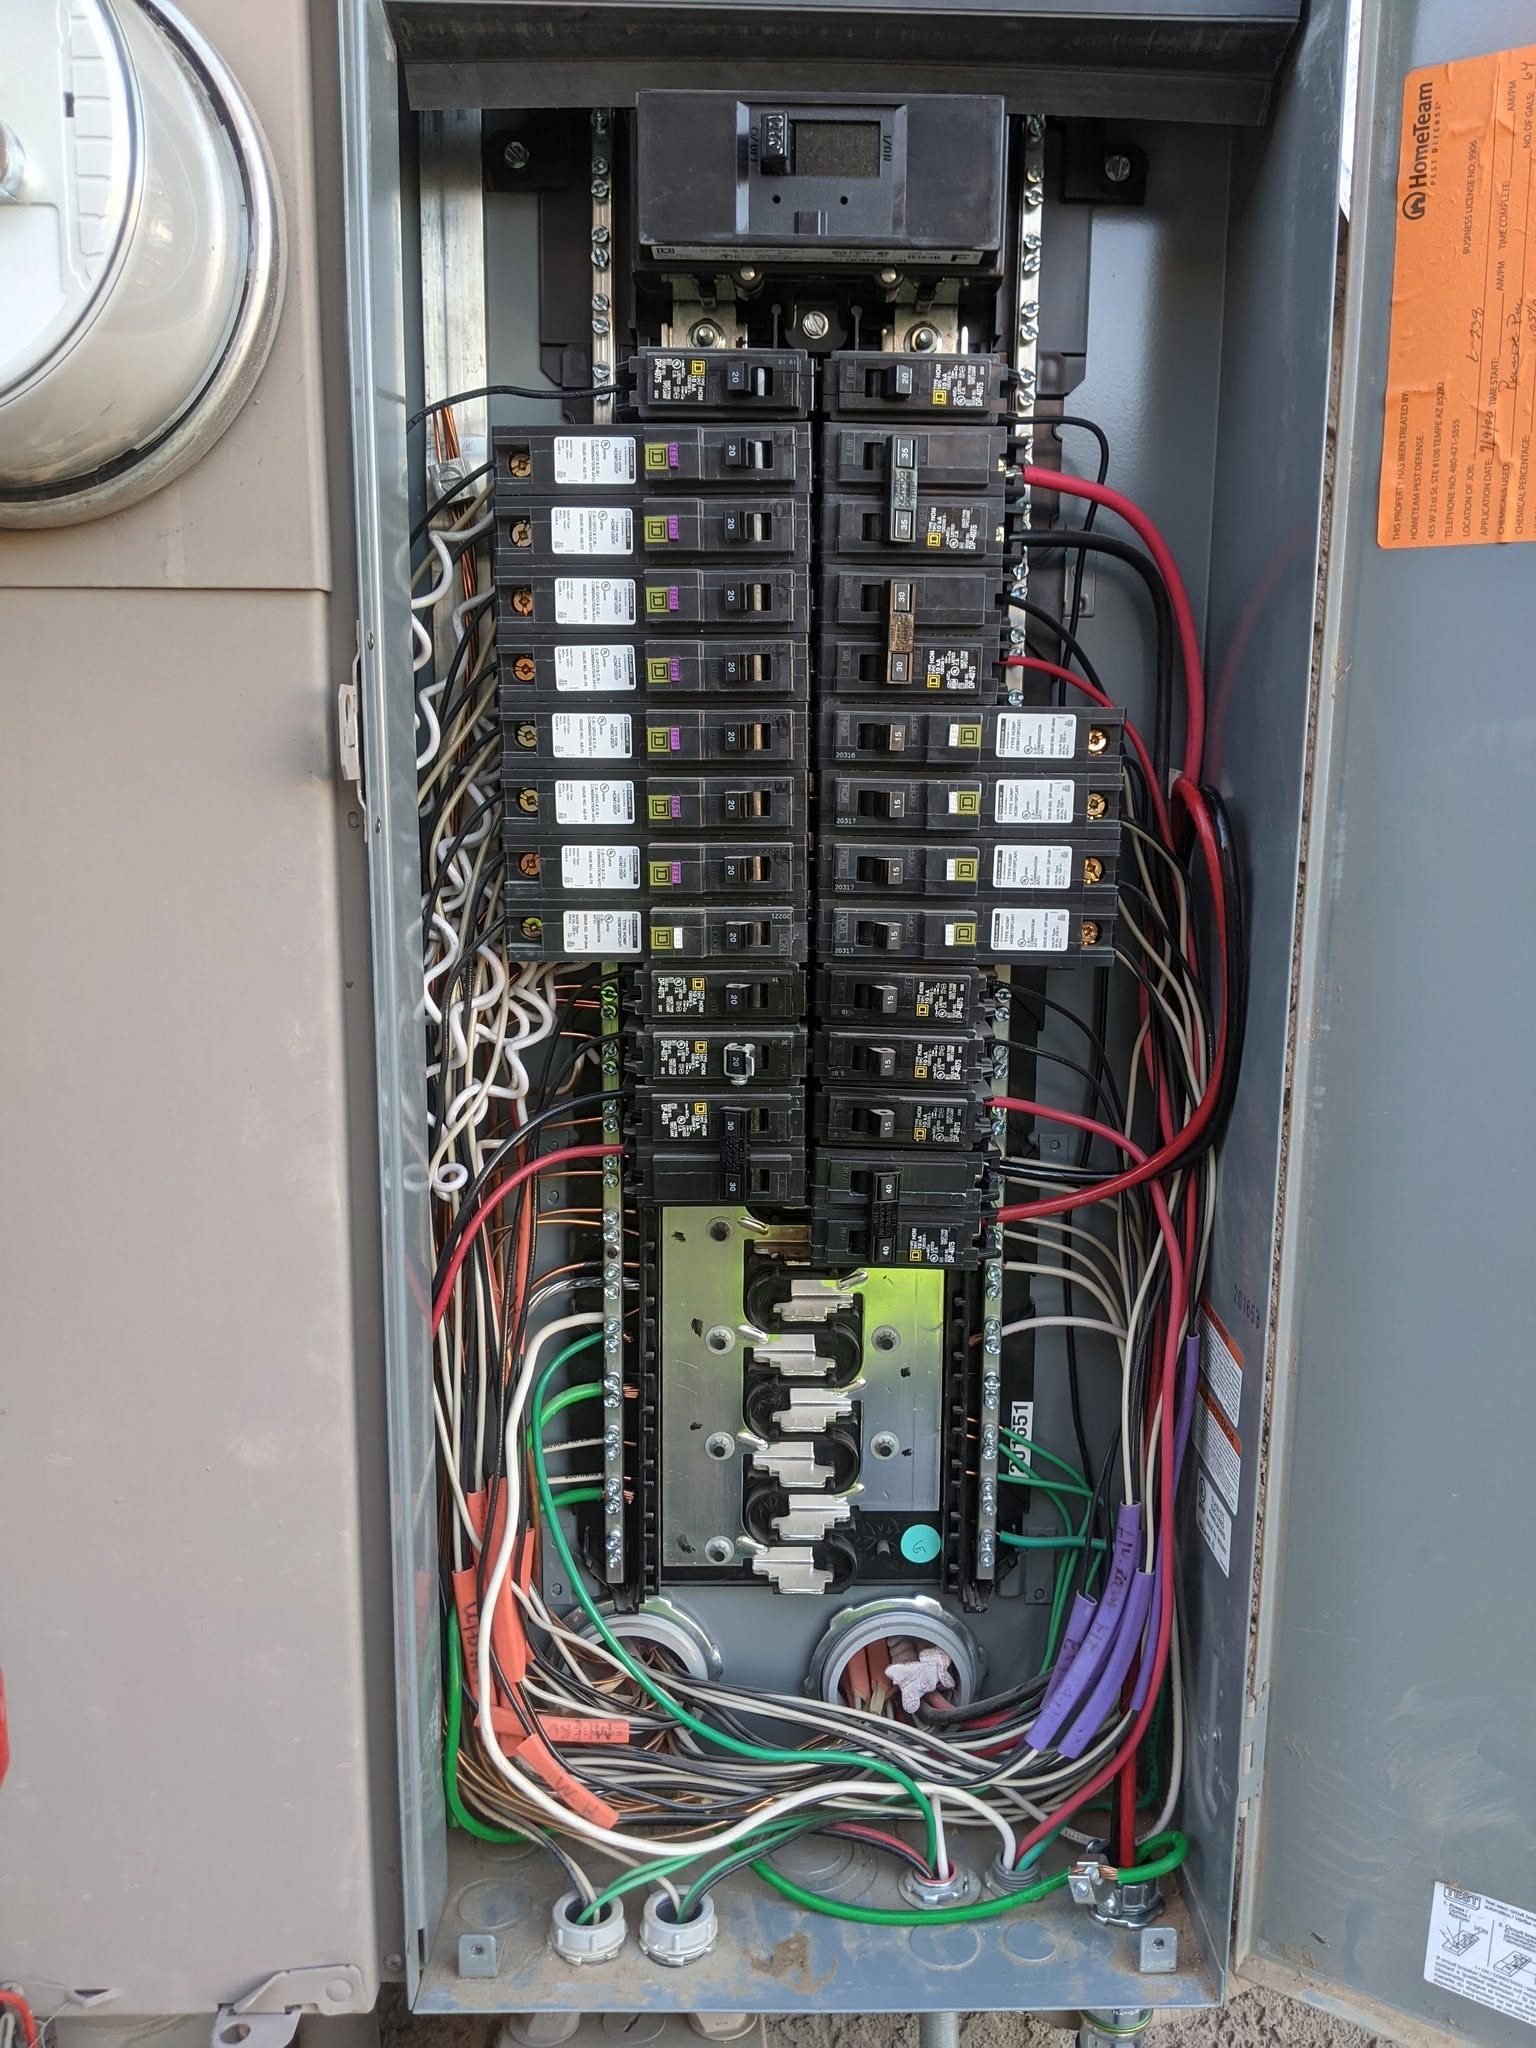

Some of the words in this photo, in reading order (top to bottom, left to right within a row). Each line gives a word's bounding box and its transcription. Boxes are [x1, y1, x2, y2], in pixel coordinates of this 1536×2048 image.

[1507, 80, 1517, 112] AM/PM
[1525, 91, 1535, 115] GALS:
[1524, 116, 1534, 131] OF
[1408, 82, 1433, 188] HomeTeam
[1522, 132, 1533, 149] NO.
[1465, 180, 1475, 213] LICENSE
[1499, 180, 1511, 227] COMPLETE:
[1463, 215, 1473, 255] BUSINESS
[1498, 229, 1508, 250] TIME
[1496, 261, 1506, 291] AM/PM
[732, 371, 739, 383] 20
[1490, 358, 1500, 385] START:
[901, 373, 909, 384] 20
[1401, 391, 1409, 403] BY:
[1488, 385, 1498, 406] TIME
[1435, 408, 1443, 419] AZ
[1399, 405, 1408, 440] TREATED
[1433, 421, 1442, 446] TEMPE
[728, 445, 736, 456] 20
[901, 448, 909, 459] 35
[1398, 441, 1406, 461] BEEN
[1518, 435, 1530, 490] PERCENTAGE:
[1397, 463, 1405, 479] HAS
[1466, 464, 1474, 482] JOB:
[1483, 458, 1493, 481] DATE:
[1500, 462, 1510, 487] USED:
[1448, 475, 1456, 489] NO:
[1464, 483, 1472, 495] OF
[1394, 482, 1404, 521] PROPERTY
[1429, 497, 1437, 513] 21st
[1445, 492, 1455, 537] TELEPHONE
[1480, 483, 1491, 536] APPLICATION
[1497, 488, 1507, 535] CHEMICALS
[1515, 492, 1526, 534] CHEMICAL
[1411, 493, 1420, 539] HOMETEAM
[1429, 514, 1435, 523] W
[1463, 496, 1472, 537] LOCATION
[728, 518, 735, 529] 20
[901, 519, 907, 530] 35
[728, 590, 735, 601] 20
[898, 592, 905, 602] 30
[728, 662, 735, 673] 20
[896, 662, 903, 672] 30
[728, 731, 735, 742] 20
[895, 733, 902, 742] 15
[728, 800, 735, 810] 20
[894, 800, 901, 809] 15
[728, 865, 735, 875] 20
[893, 867, 900, 876] 15
[730, 933, 737, 942] 20
[891, 931, 898, 941] 15
[731, 995, 737, 1004] 20
[888, 995, 893, 1004] 15
[733, 1057, 739, 1066] 20
[885, 1059, 891, 1069] 15
[728, 1121, 734, 1130] 30
[885, 1122, 891, 1131] 15
[730, 1182, 736, 1191] 30
[886, 1184, 892, 1194] 40
[883, 1246, 889, 1255] 40
